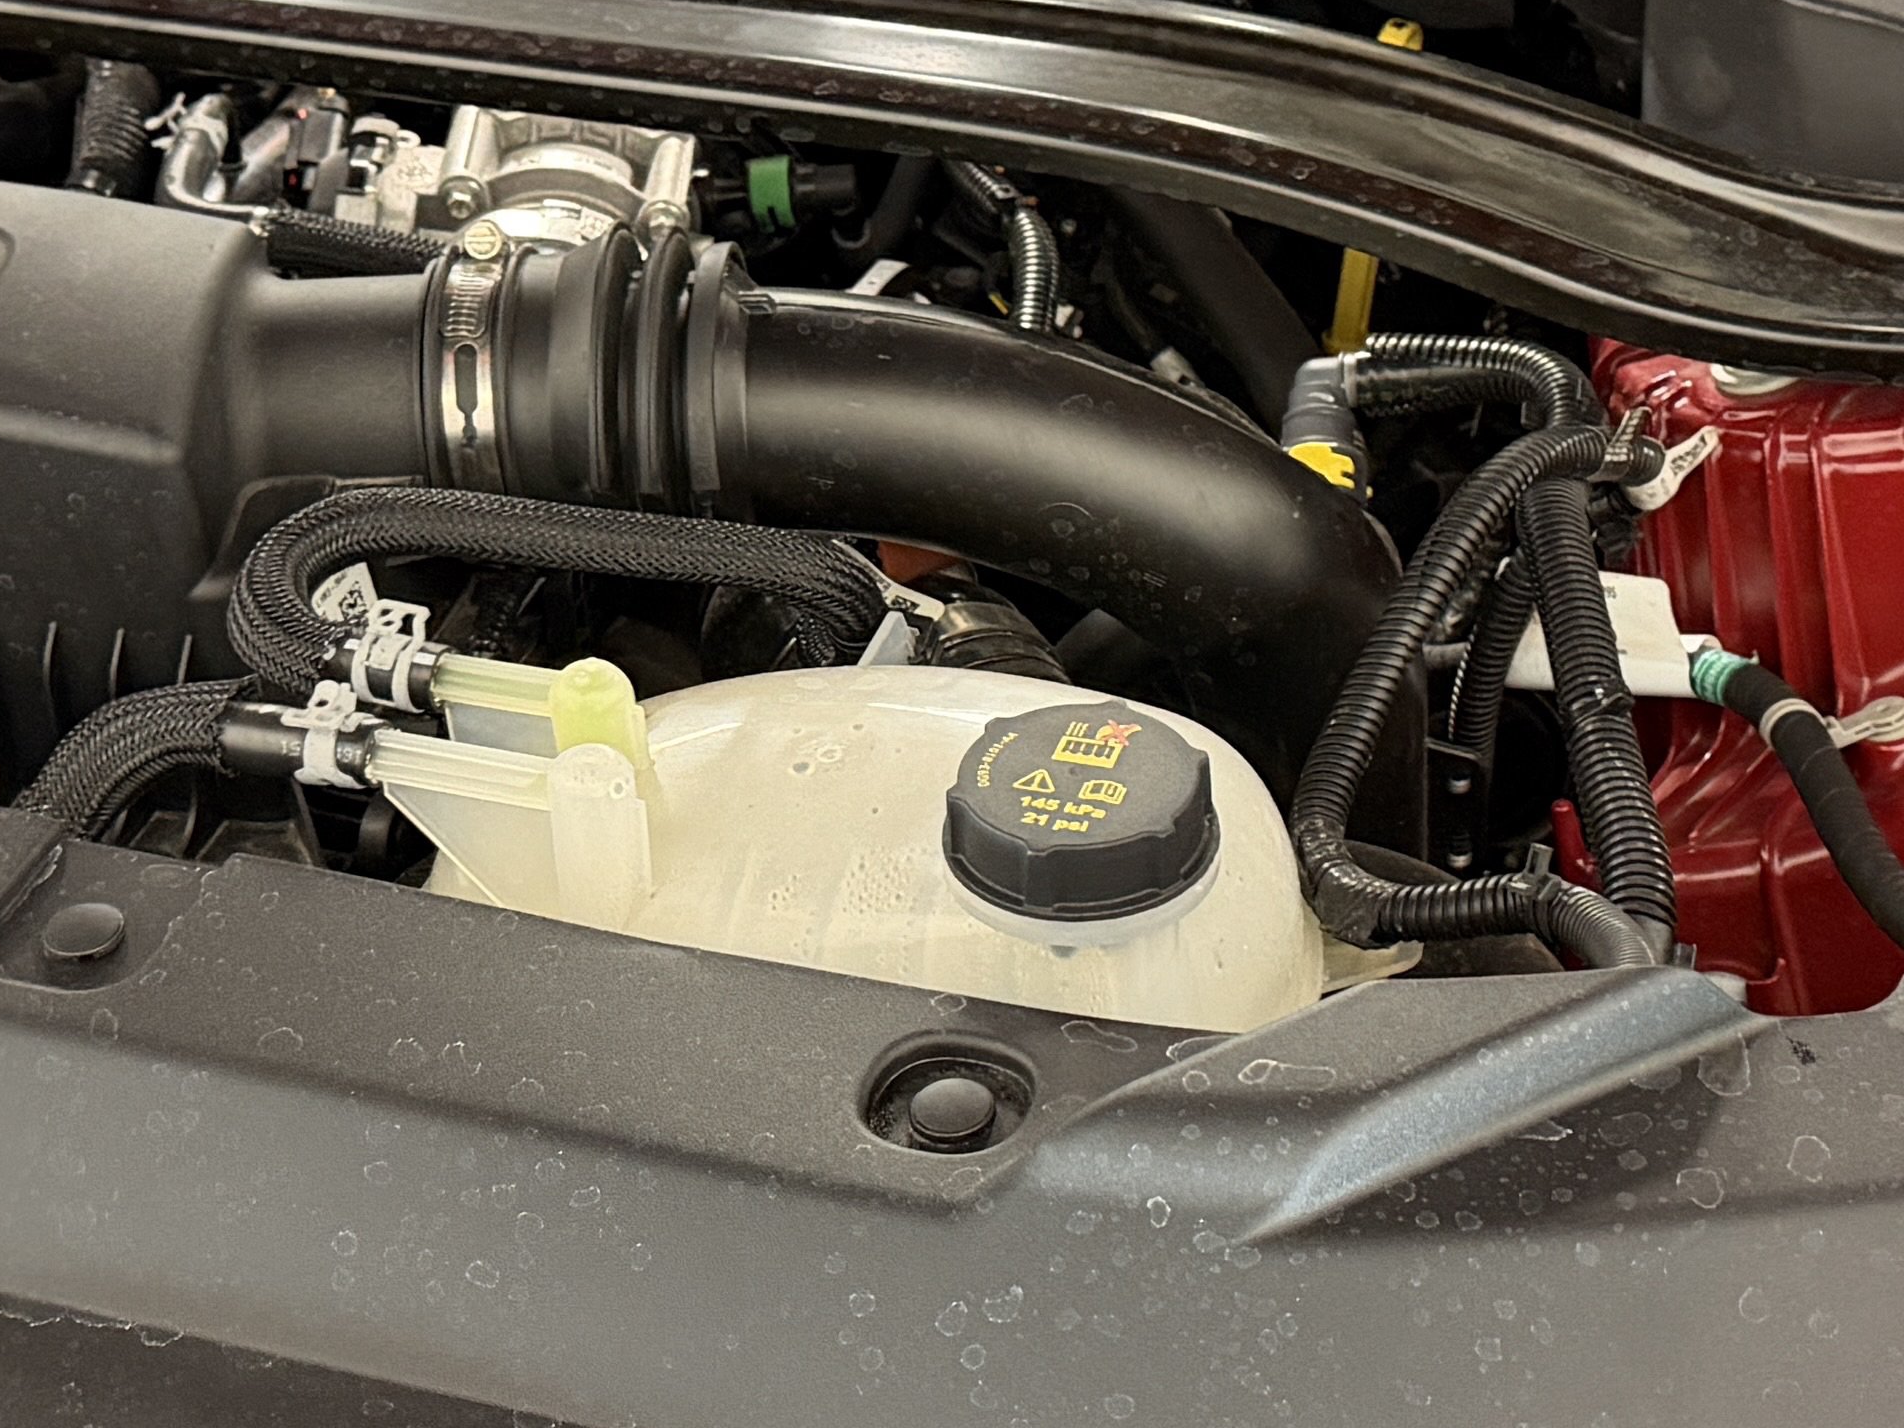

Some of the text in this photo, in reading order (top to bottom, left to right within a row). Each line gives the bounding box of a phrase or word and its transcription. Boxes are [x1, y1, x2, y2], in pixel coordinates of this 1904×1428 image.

[1020, 796, 1106, 819] 145 kPa
[1021, 811, 1089, 832] 21 psi
